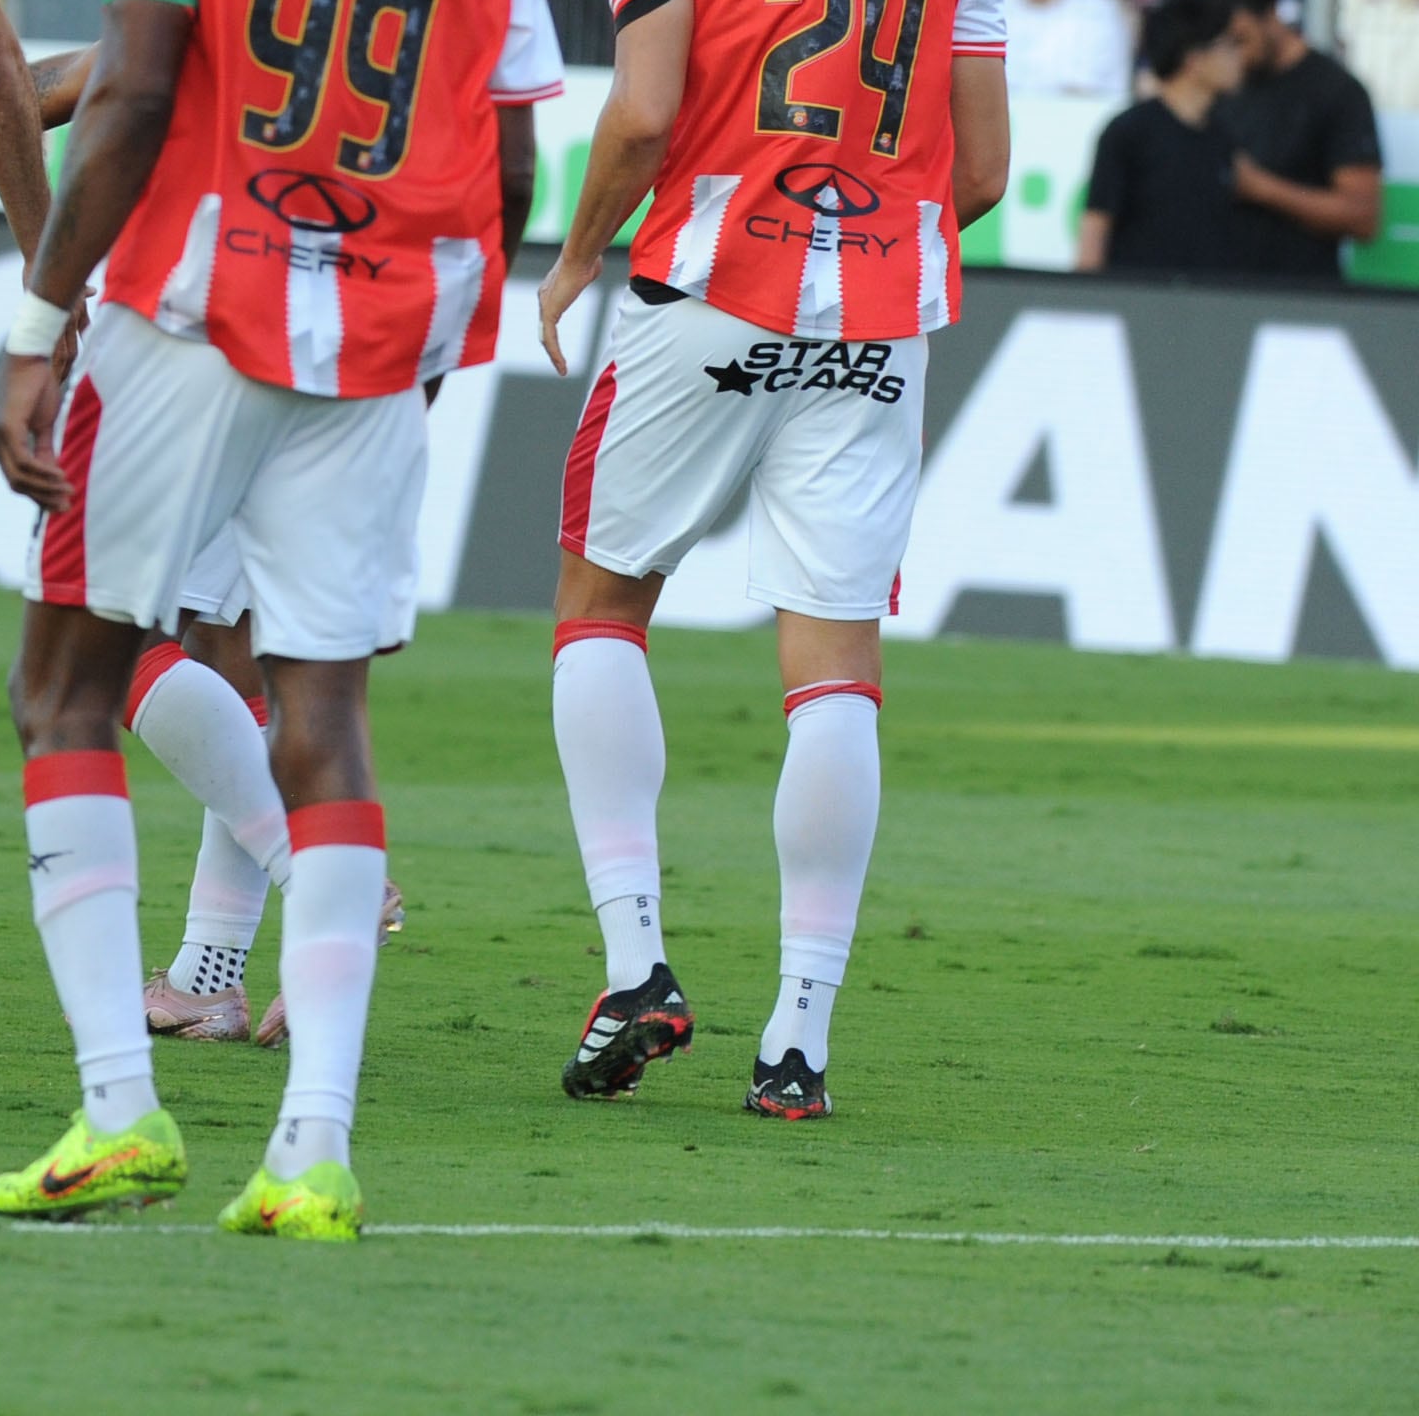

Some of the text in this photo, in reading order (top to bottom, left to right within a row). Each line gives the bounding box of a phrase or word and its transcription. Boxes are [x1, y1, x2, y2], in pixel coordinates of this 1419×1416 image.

[224, 228, 391, 281] CHERY
[745, 215, 899, 258] CHERY
[744, 342, 892, 372] STAR
[764, 367, 906, 404] CARS
